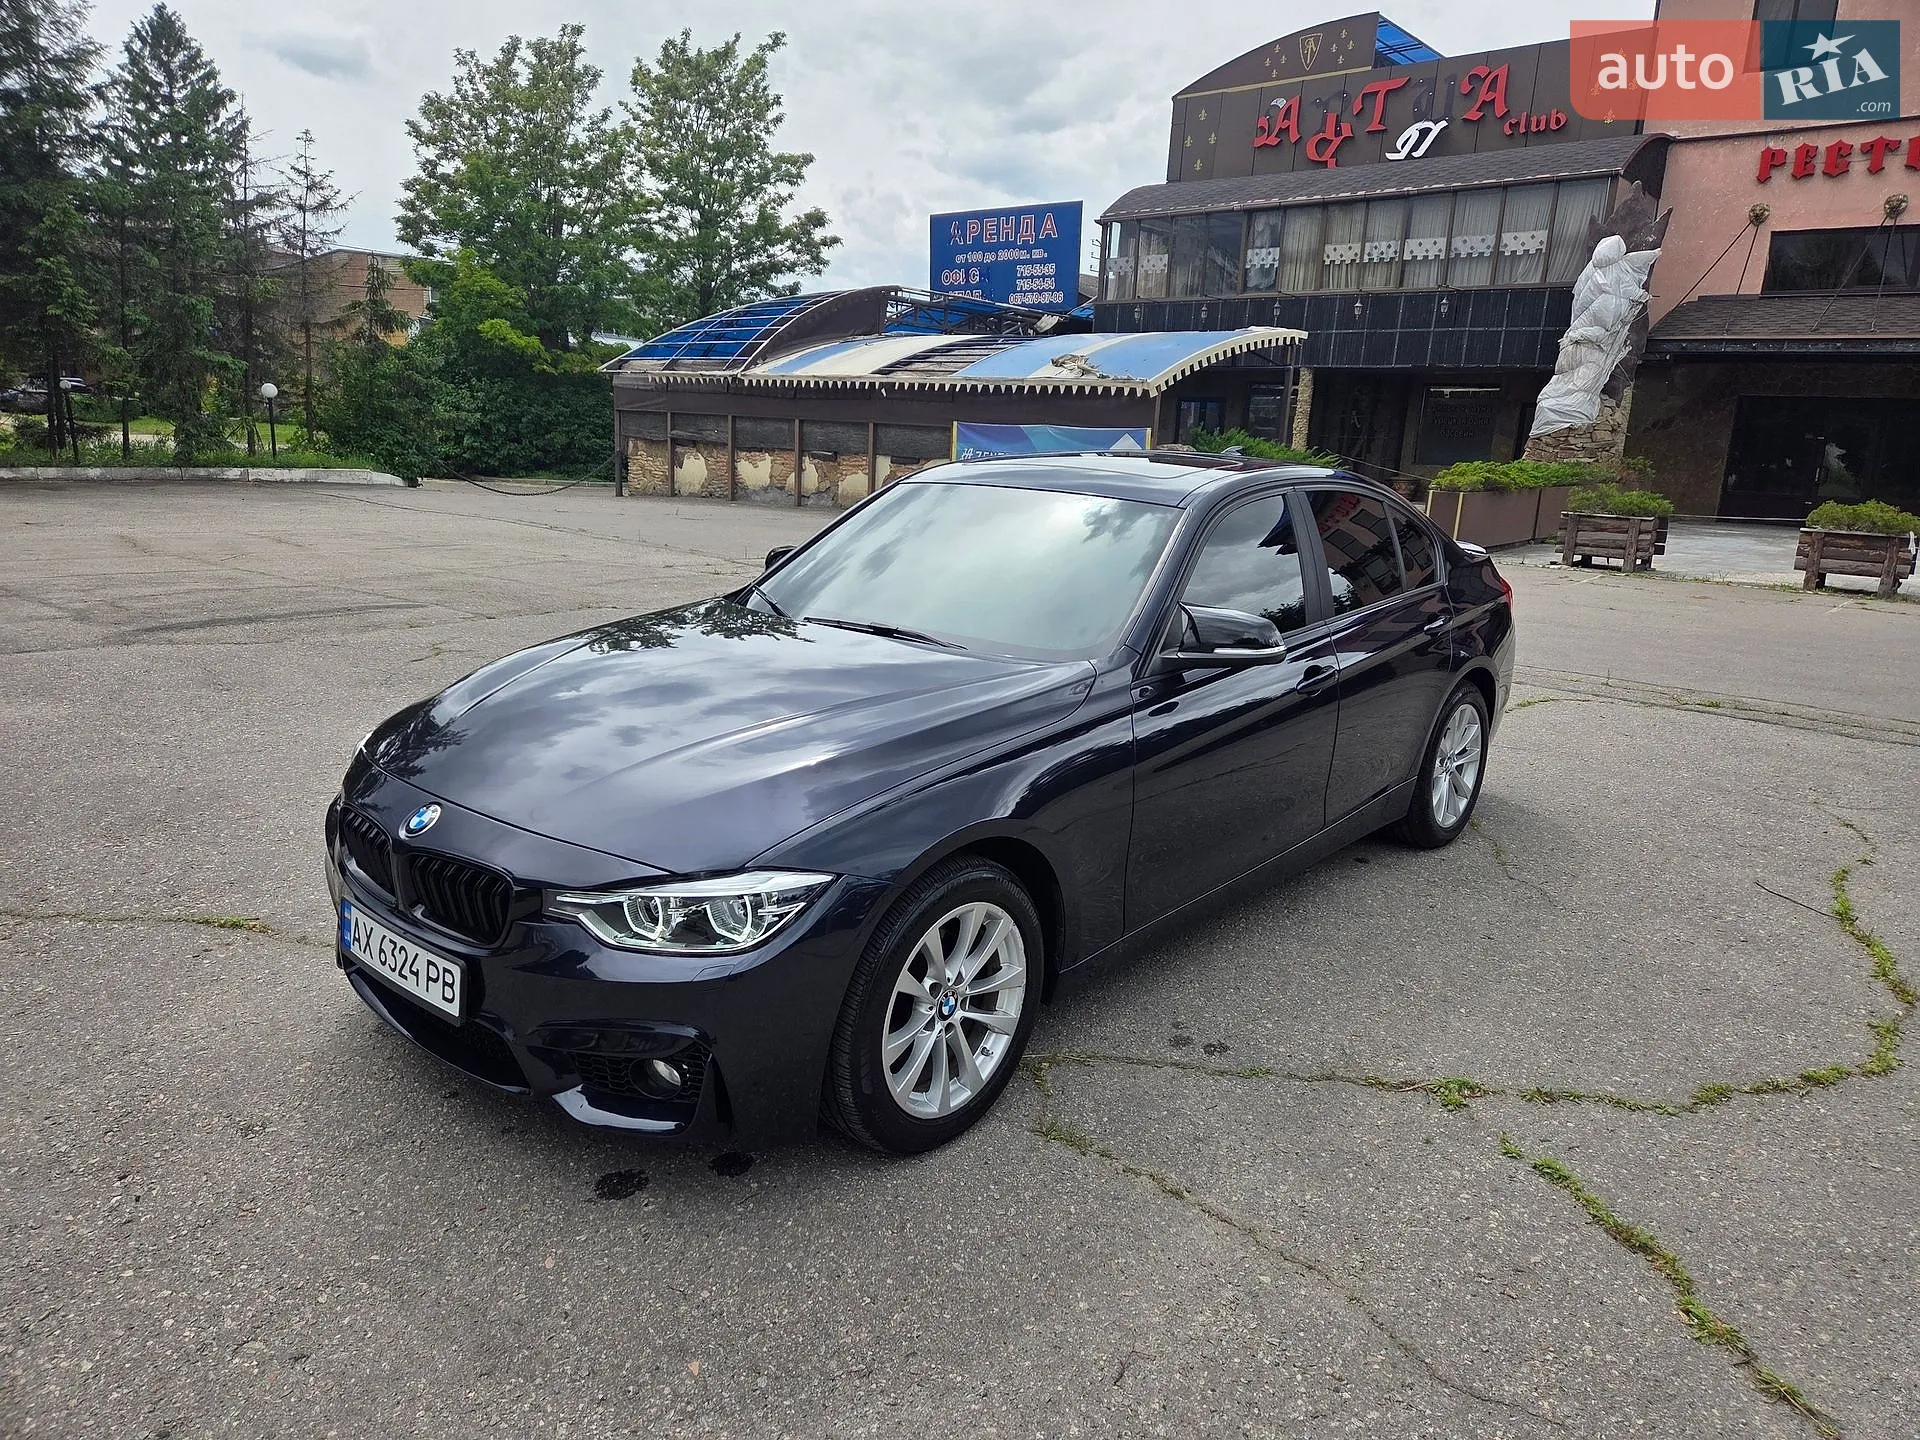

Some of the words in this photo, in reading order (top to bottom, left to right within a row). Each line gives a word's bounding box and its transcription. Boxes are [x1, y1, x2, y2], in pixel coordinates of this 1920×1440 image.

[1503, 108, 1567, 136] club
[949, 212, 1058, 245] АРЕНДА
[956, 254, 967, 264] от
[967, 251, 984, 263] 100
[984, 252, 997, 263] до
[352, 916, 374, 960] AX
[378, 933, 420, 988] 6324
[426, 958, 457, 1004] PB
